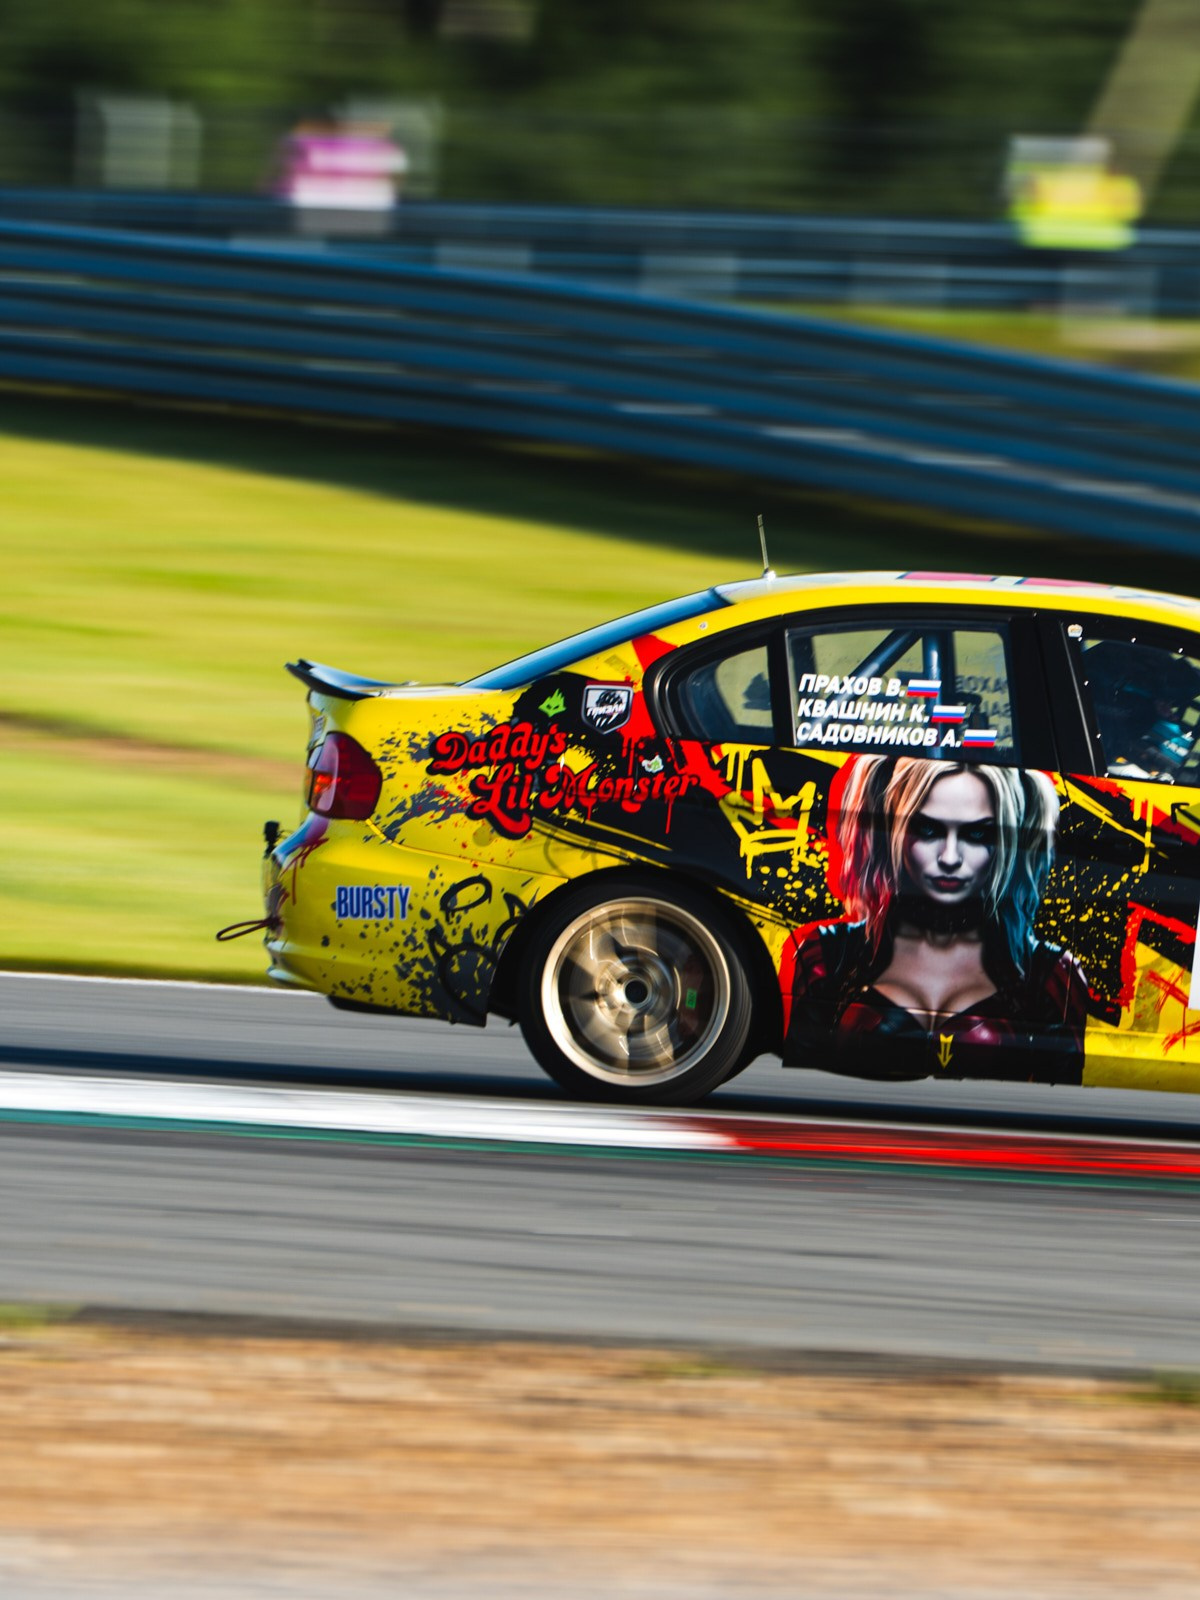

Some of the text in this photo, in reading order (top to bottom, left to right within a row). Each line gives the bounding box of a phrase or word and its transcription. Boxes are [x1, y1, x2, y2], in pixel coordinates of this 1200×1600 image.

[798, 673, 905, 697] ПРАХОВ В.
[797, 698, 929, 723] КВАШНИН К.
[432, 722, 567, 769] Daddy's
[796, 723, 961, 747] САДОВНИКОВ А.
[470, 762, 700, 834] Lil Monster
[336, 886, 410, 920] BURSTY
